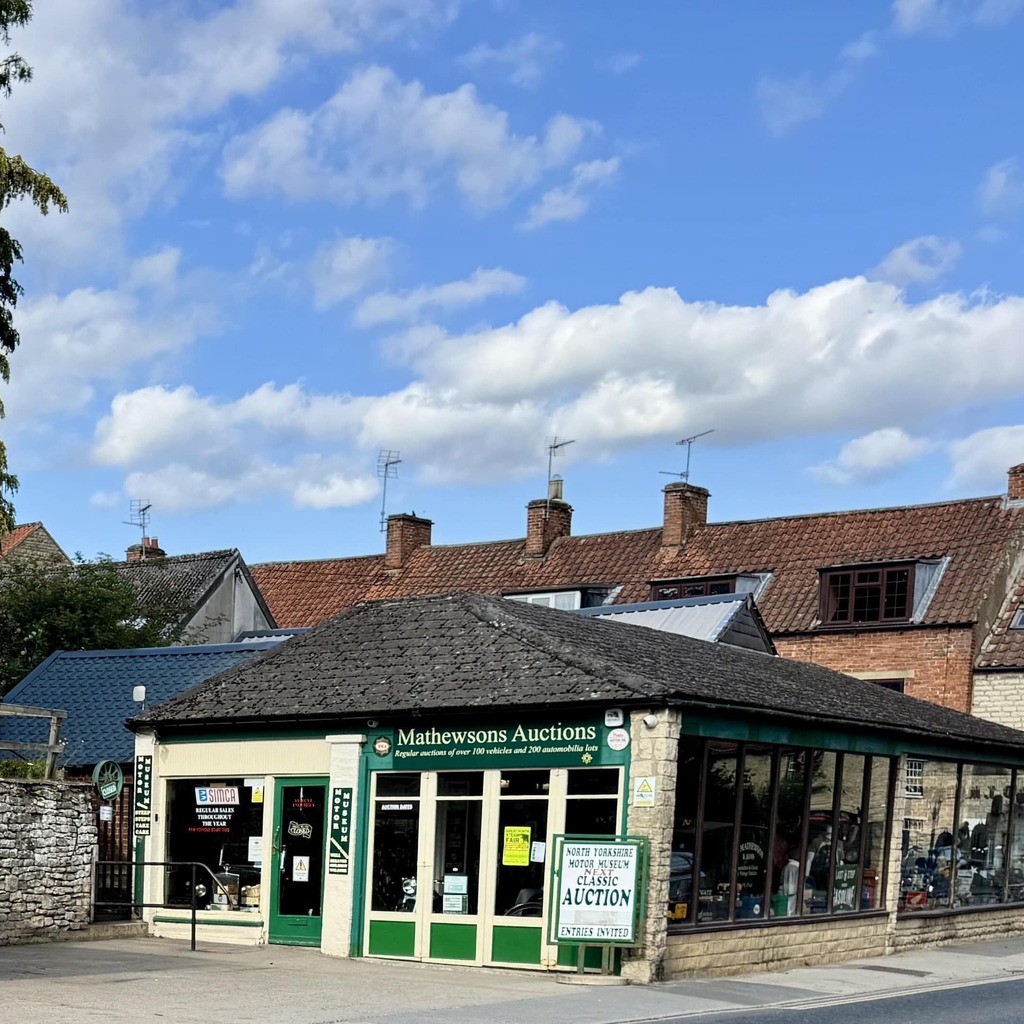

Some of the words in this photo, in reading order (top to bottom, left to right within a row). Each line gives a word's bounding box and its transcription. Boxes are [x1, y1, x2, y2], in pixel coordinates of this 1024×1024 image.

[397, 727, 506, 746] Mathewsons
[512, 723, 596, 742] Auctions
[395, 750, 418, 758] Regular
[473, 747, 485, 755] 100
[486, 746, 512, 754] vehicles
[514, 746, 526, 754] and
[542, 744, 583, 752] automobilia
[209, 788, 236, 802] SIMCA
[333, 789, 342, 829] MOTOR
[341, 793, 350, 842] MUSEUM
[566, 847, 590, 856] NORTH
[594, 848, 633, 857] YORKSHIRE
[568, 859, 594, 868] MOTOR
[598, 860, 629, 869] MUSEUM
[577, 876, 618, 886] CLASSIC
[562, 888, 631, 906] AUCTION
[561, 927, 593, 936] ENTRIES
[597, 928, 629, 937] INVITED
